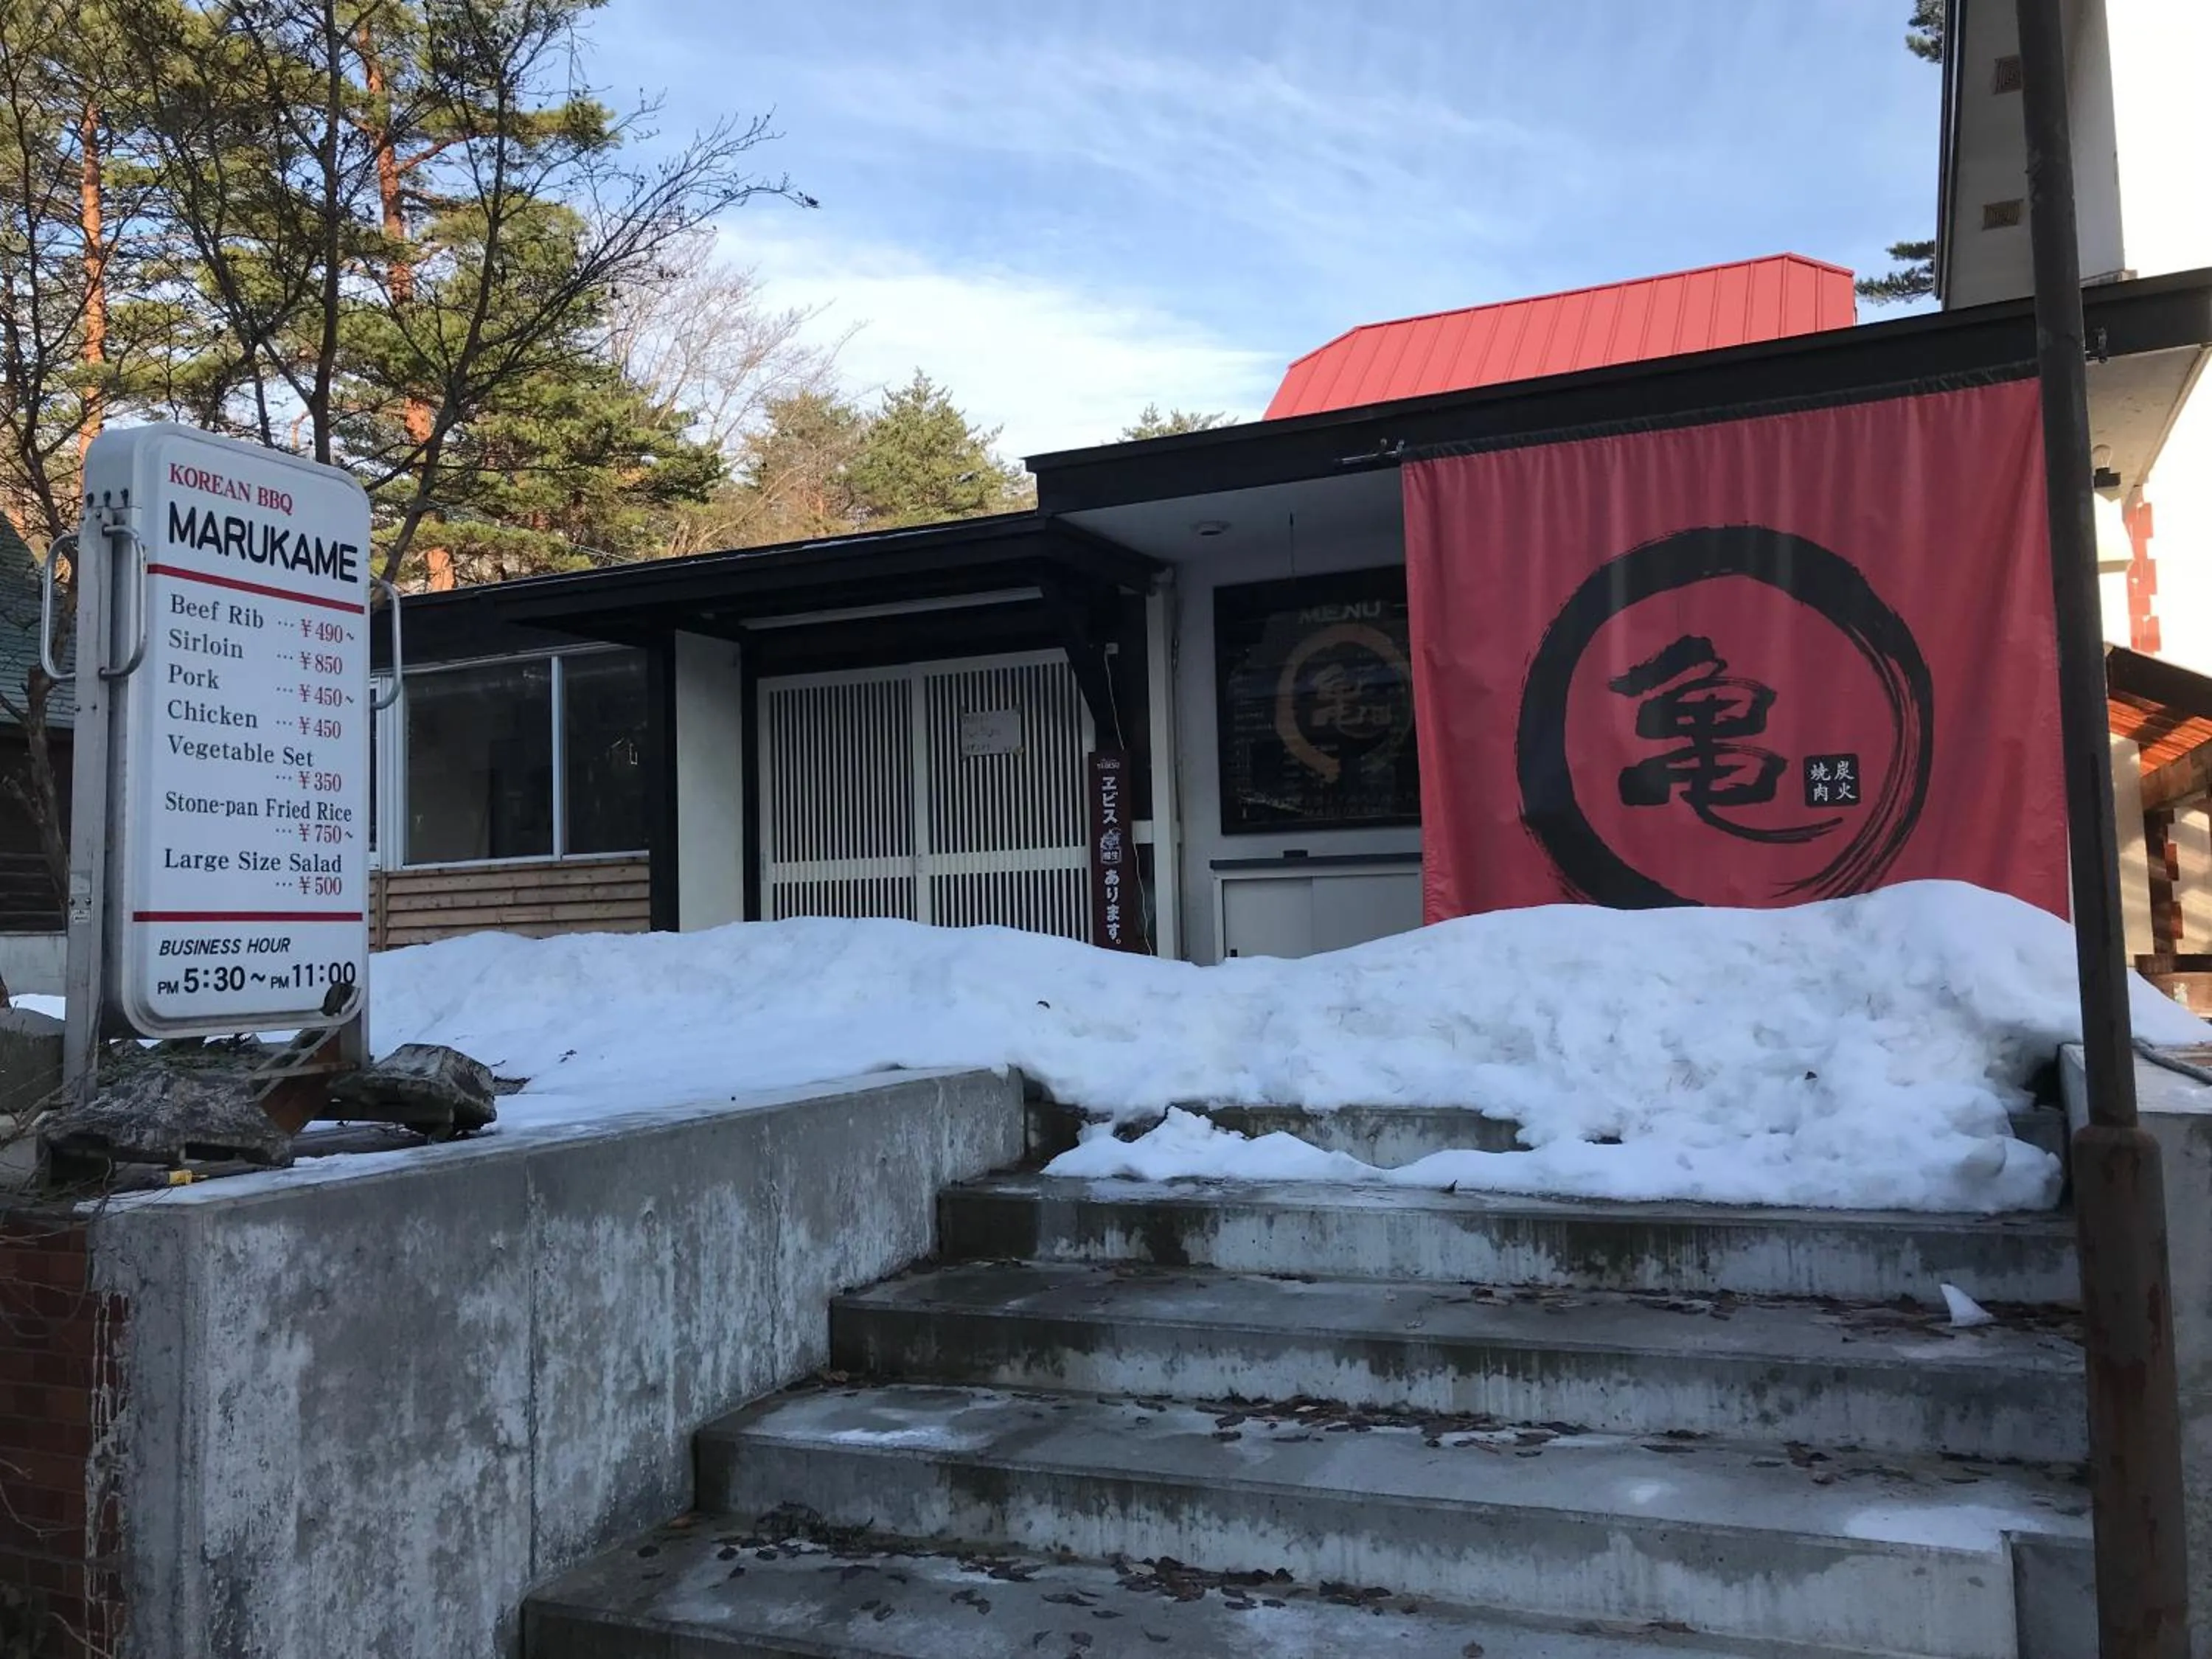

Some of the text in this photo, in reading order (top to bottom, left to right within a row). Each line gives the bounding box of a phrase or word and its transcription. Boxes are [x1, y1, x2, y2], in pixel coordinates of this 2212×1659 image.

[170, 463, 293, 516] KOREAN BBQ
[169, 501, 358, 583] MARUKAME
[170, 593, 220, 621] Beef
[229, 605, 264, 629] Rib
[1296, 599, 1382, 625] MENU
[168, 628, 244, 659] Sirloin
[168, 663, 220, 689] Pork
[167, 699, 258, 728] Chicken
[167, 734, 314, 768] Vegetable Set
[1608, 634, 1843, 844] 亀
[165, 790, 352, 822] Stone-pan Fried Rice
[164, 849, 342, 873] Large Size Salad
[159, 937, 291, 956] BUSINESS HOUR
[157, 981, 179, 995] PM
[271, 975, 290, 990] PM
